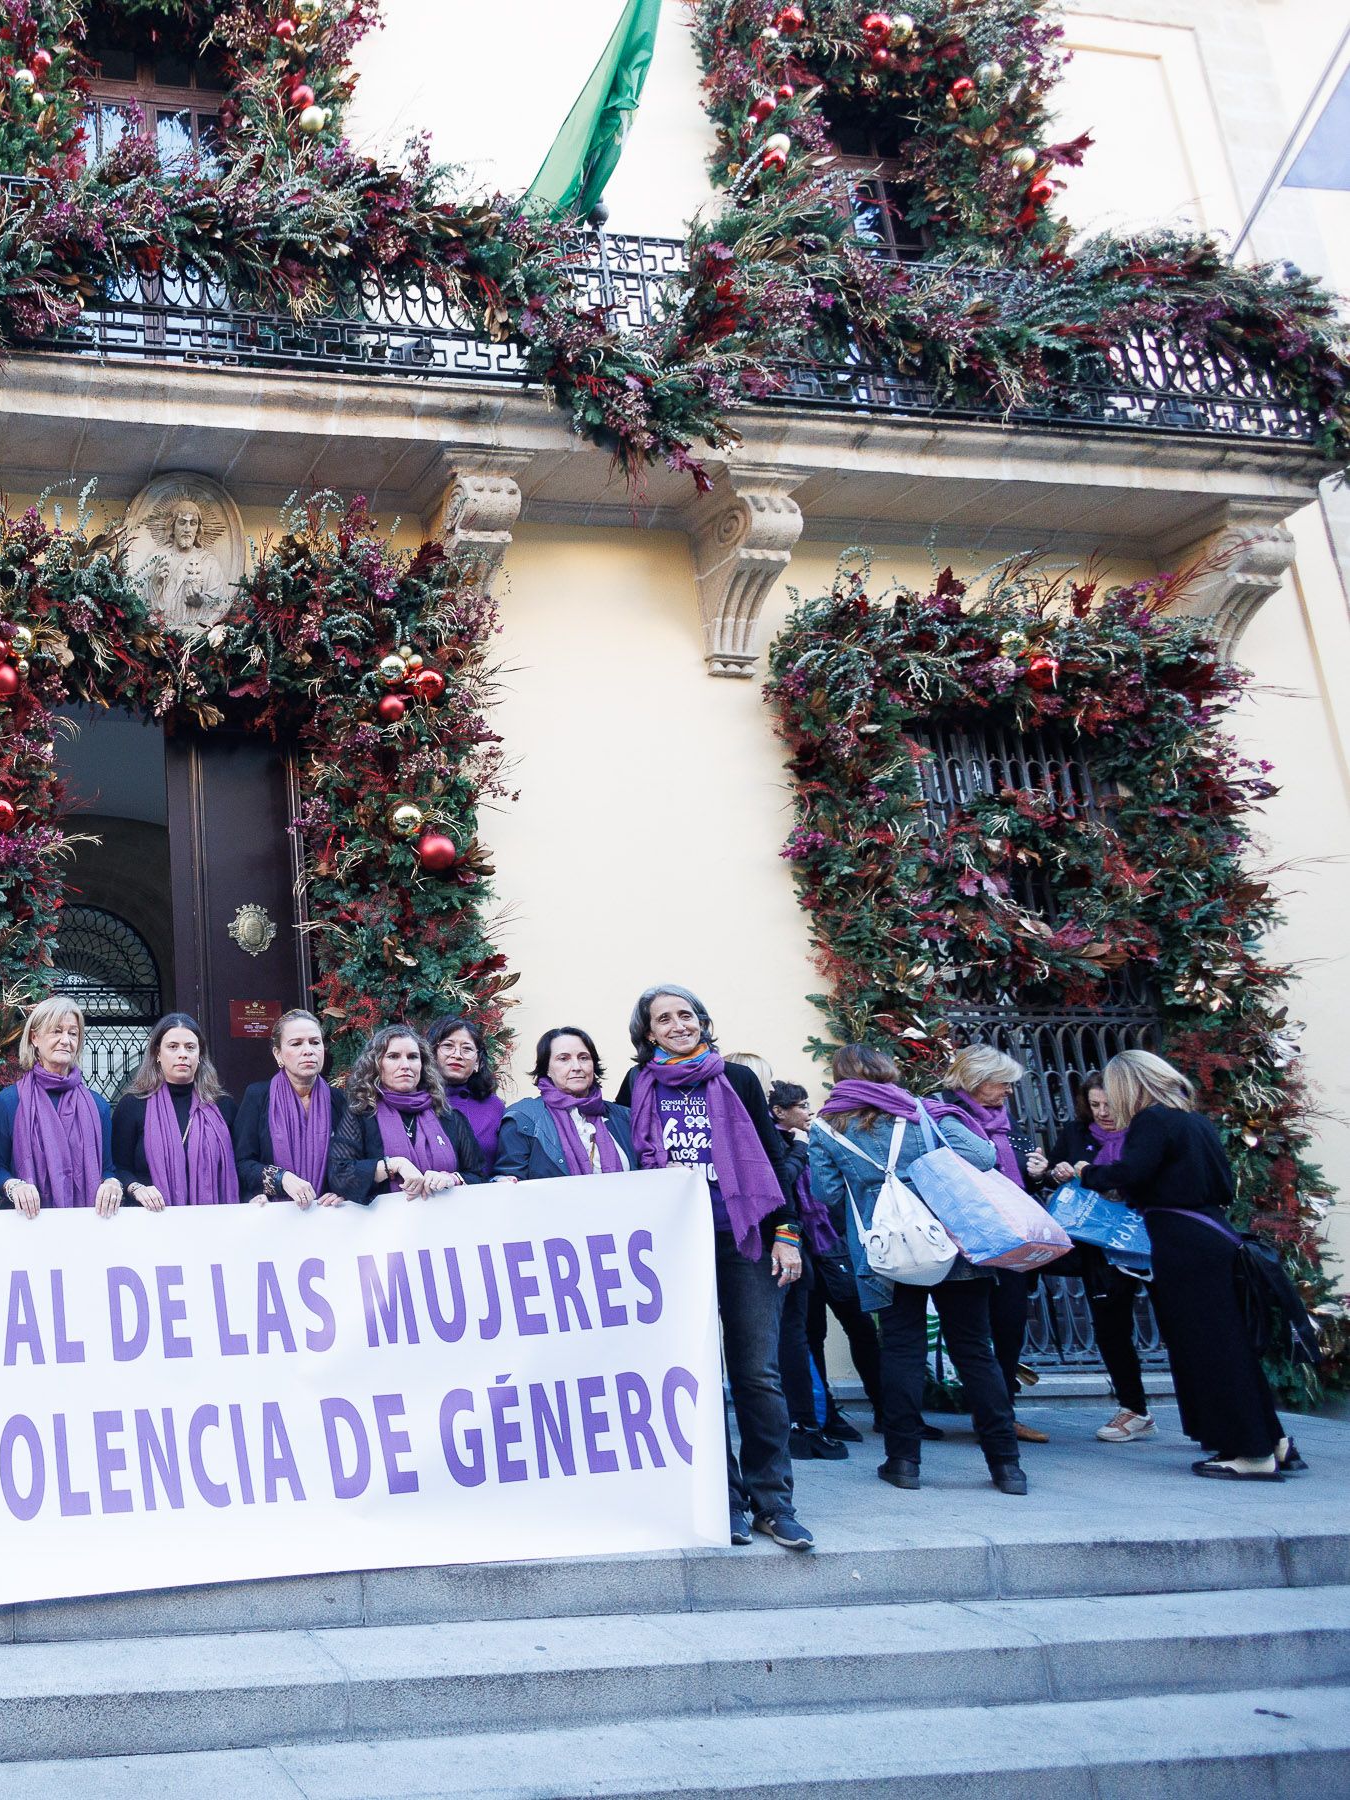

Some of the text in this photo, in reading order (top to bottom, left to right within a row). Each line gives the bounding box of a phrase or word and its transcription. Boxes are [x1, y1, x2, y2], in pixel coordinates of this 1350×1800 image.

[670, 1148, 699, 1161] nos
[106, 1266, 194, 1362] DE
[210, 1257, 336, 1357] LAS
[356, 1229, 664, 1348] MUJERES
[319, 1392, 419, 1500] DE
